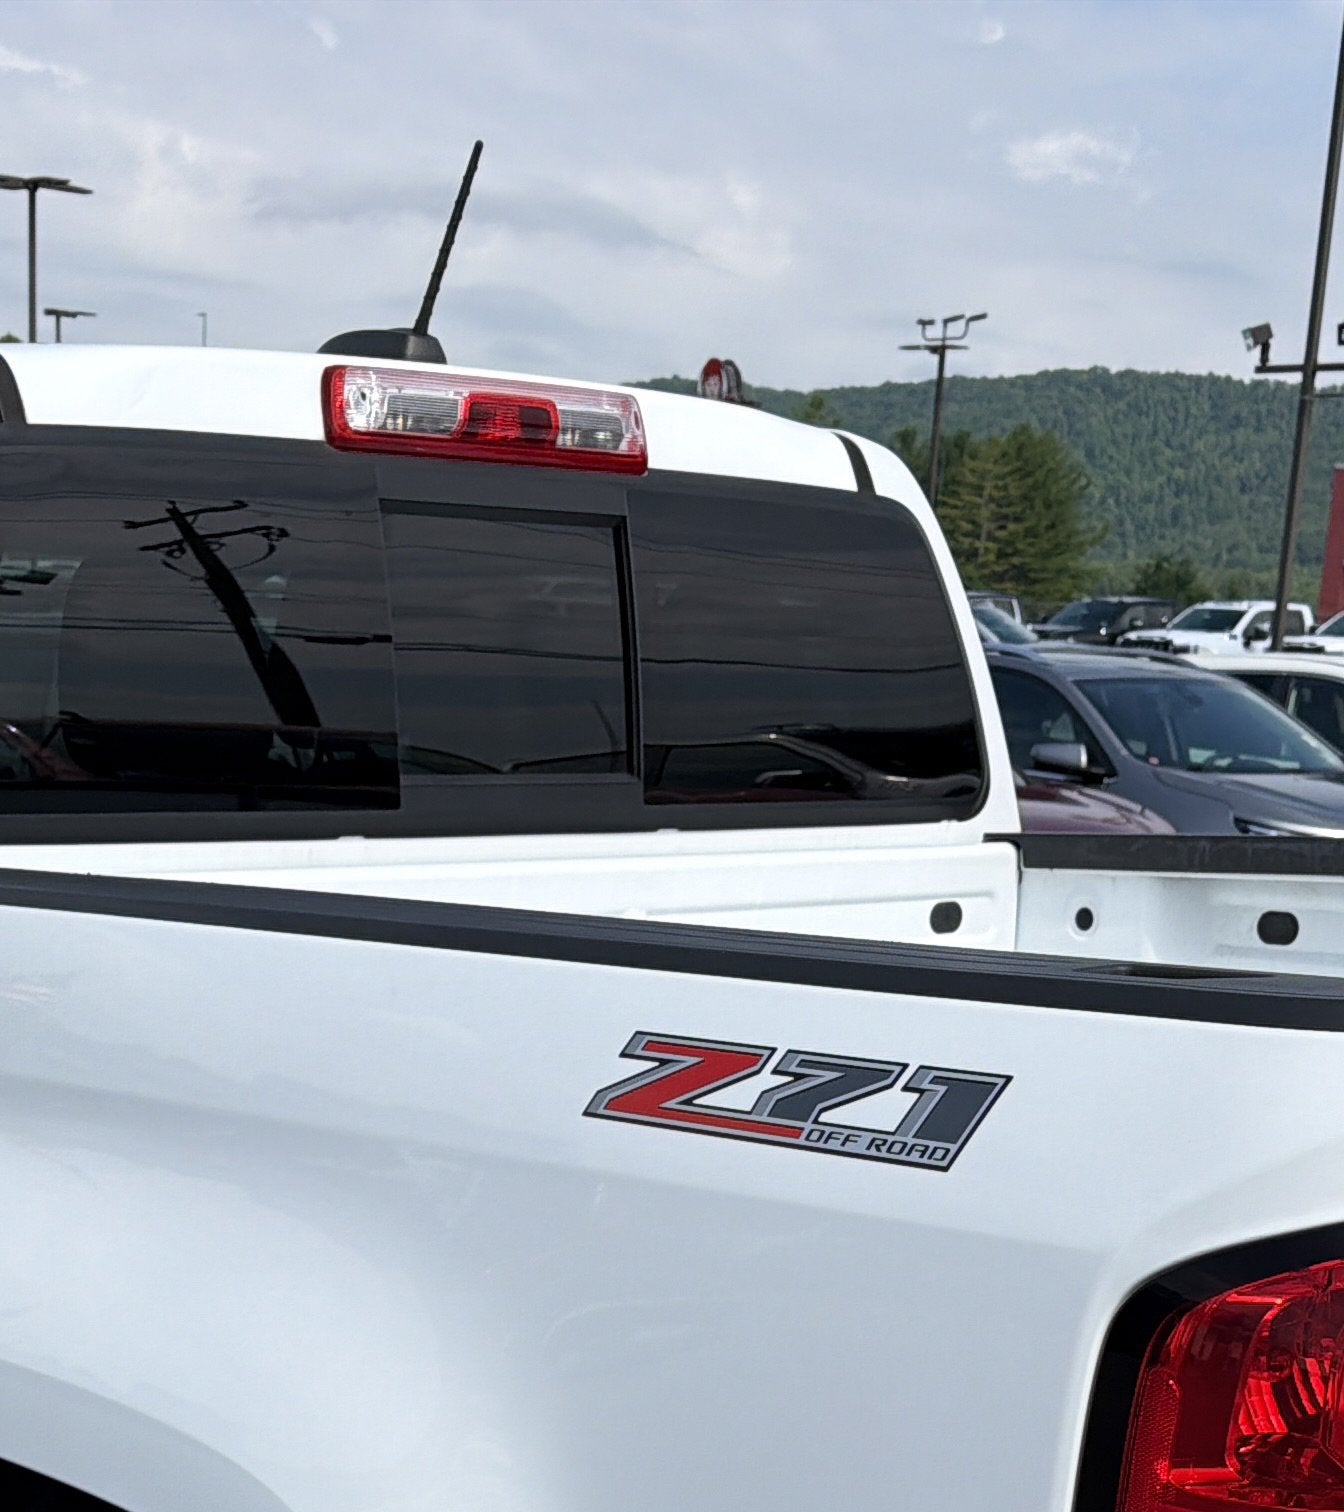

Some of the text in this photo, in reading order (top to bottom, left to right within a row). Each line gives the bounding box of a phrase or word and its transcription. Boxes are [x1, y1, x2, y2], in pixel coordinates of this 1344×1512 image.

[582, 1030, 1014, 1160] Z71
[804, 1128, 951, 1163] OFF ROAD
